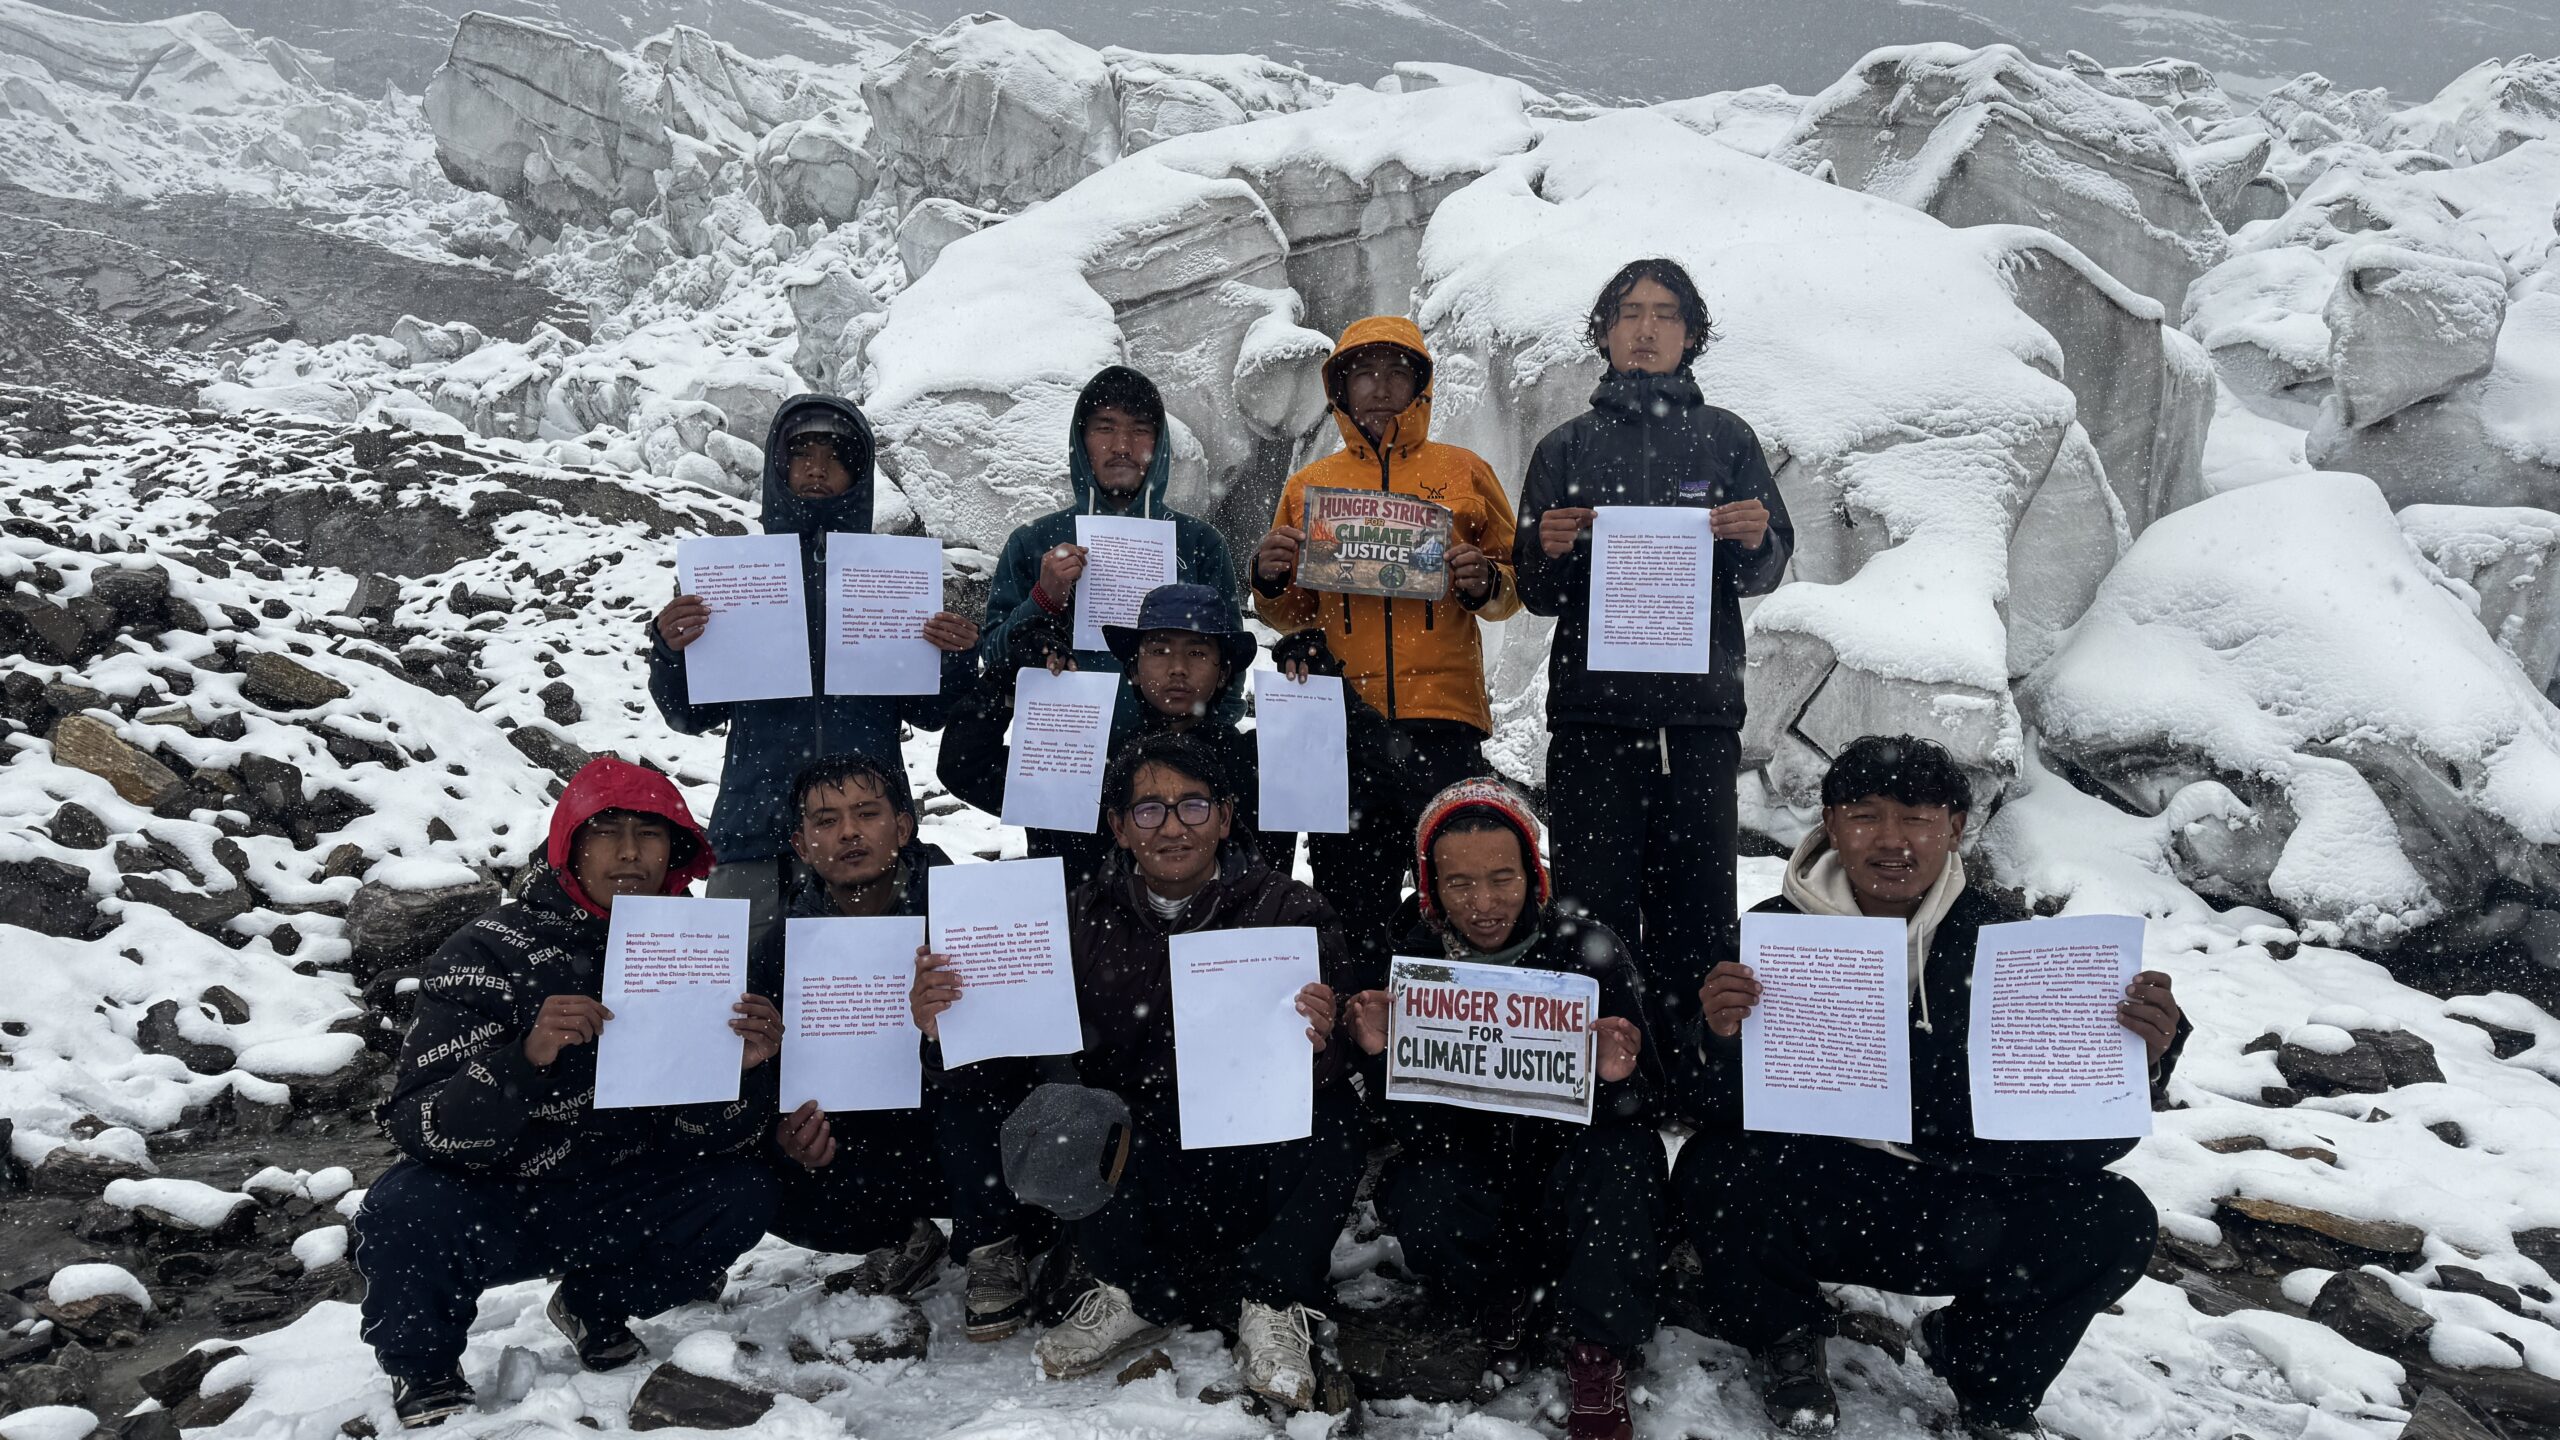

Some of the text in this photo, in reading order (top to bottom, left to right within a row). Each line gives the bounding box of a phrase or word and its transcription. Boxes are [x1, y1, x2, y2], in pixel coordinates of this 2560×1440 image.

[1320, 496, 1439, 529] HUNGER STRIKE
[1364, 517, 1385, 526] FOR
[1335, 523, 1413, 546] CLIMATE
[1334, 542, 1409, 564] JUSTICE
[450, 965, 485, 974] PARIS
[1406, 986, 1584, 1032] HUNGER STRIKE
[1469, 1026, 1504, 1044] FOR
[455, 1040, 490, 1062] PARIS
[1397, 1036, 1576, 1084] CLIMATE JUSTICE
